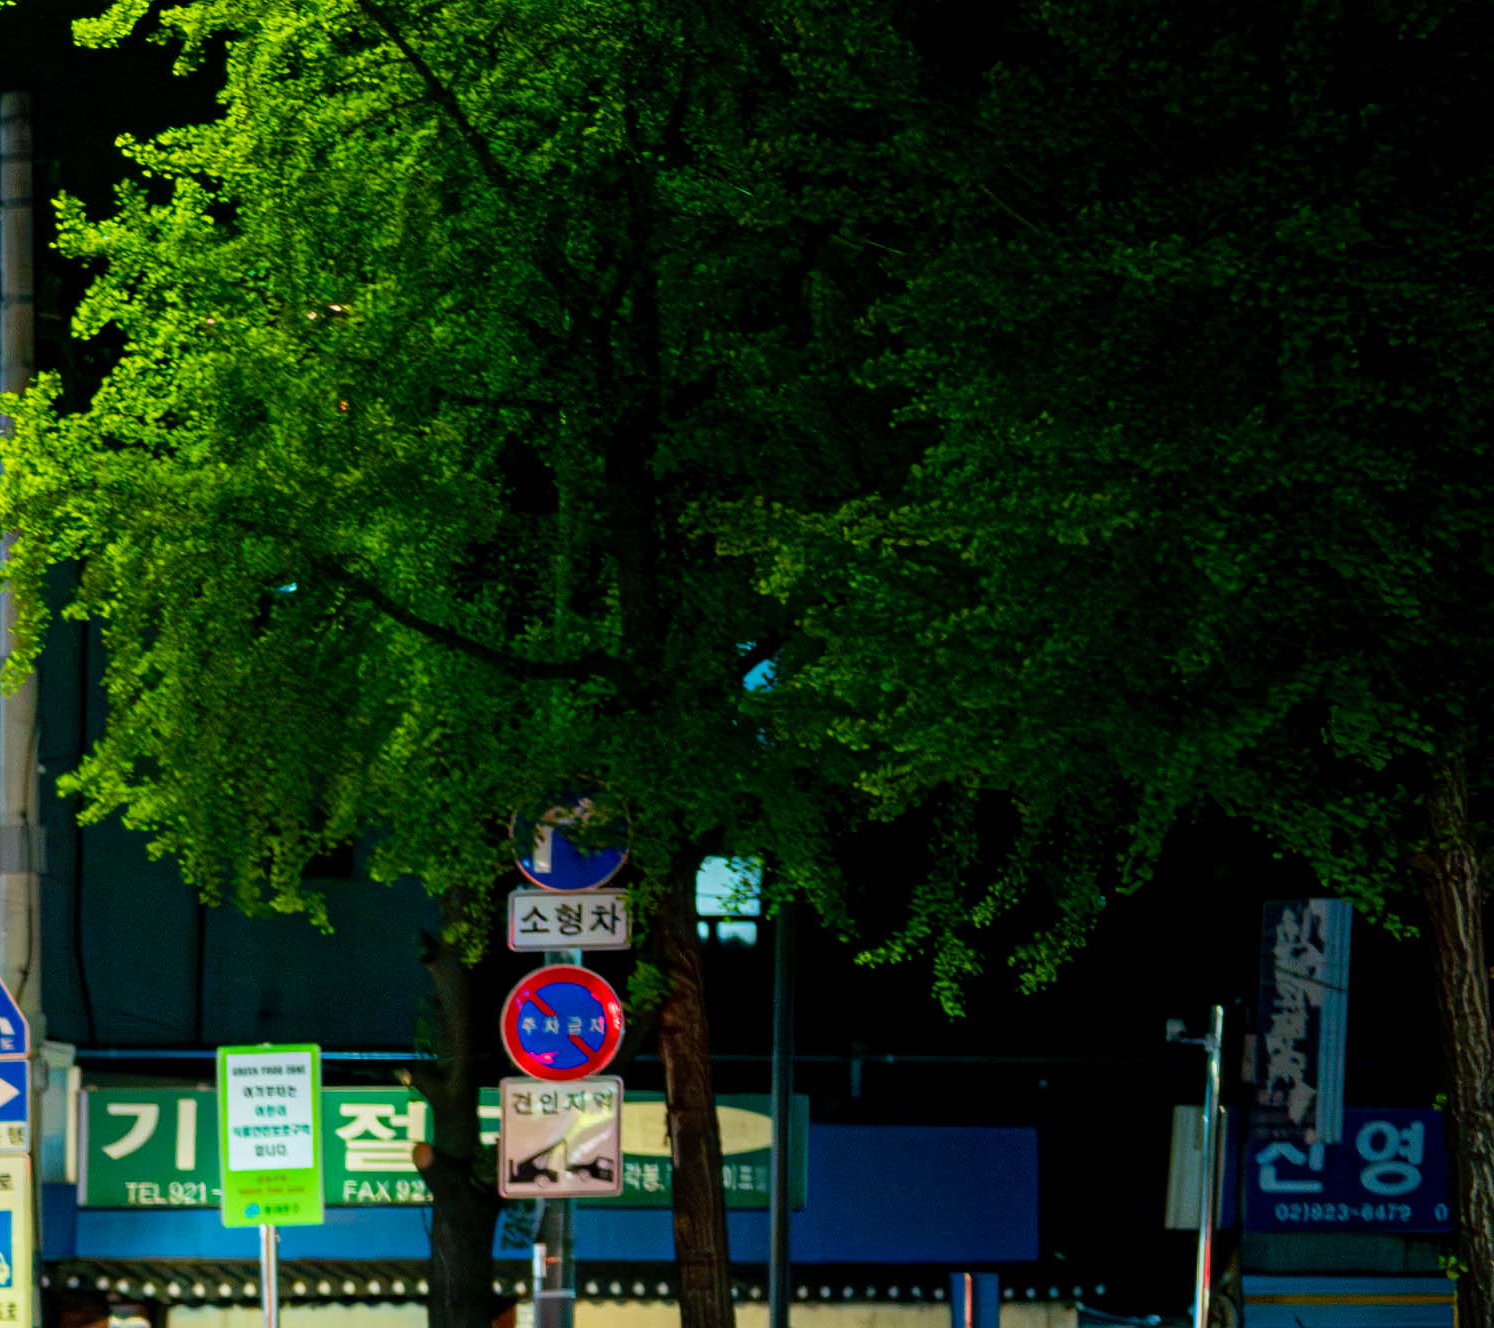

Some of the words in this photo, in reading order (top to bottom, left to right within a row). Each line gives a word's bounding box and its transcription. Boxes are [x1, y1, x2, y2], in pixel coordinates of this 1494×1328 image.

[519, 902, 621, 937] 소형차
[521, 1016, 606, 1036] 주차금지
[125, 1181, 167, 1204] TEL
[343, 1180, 390, 1202] FAX
